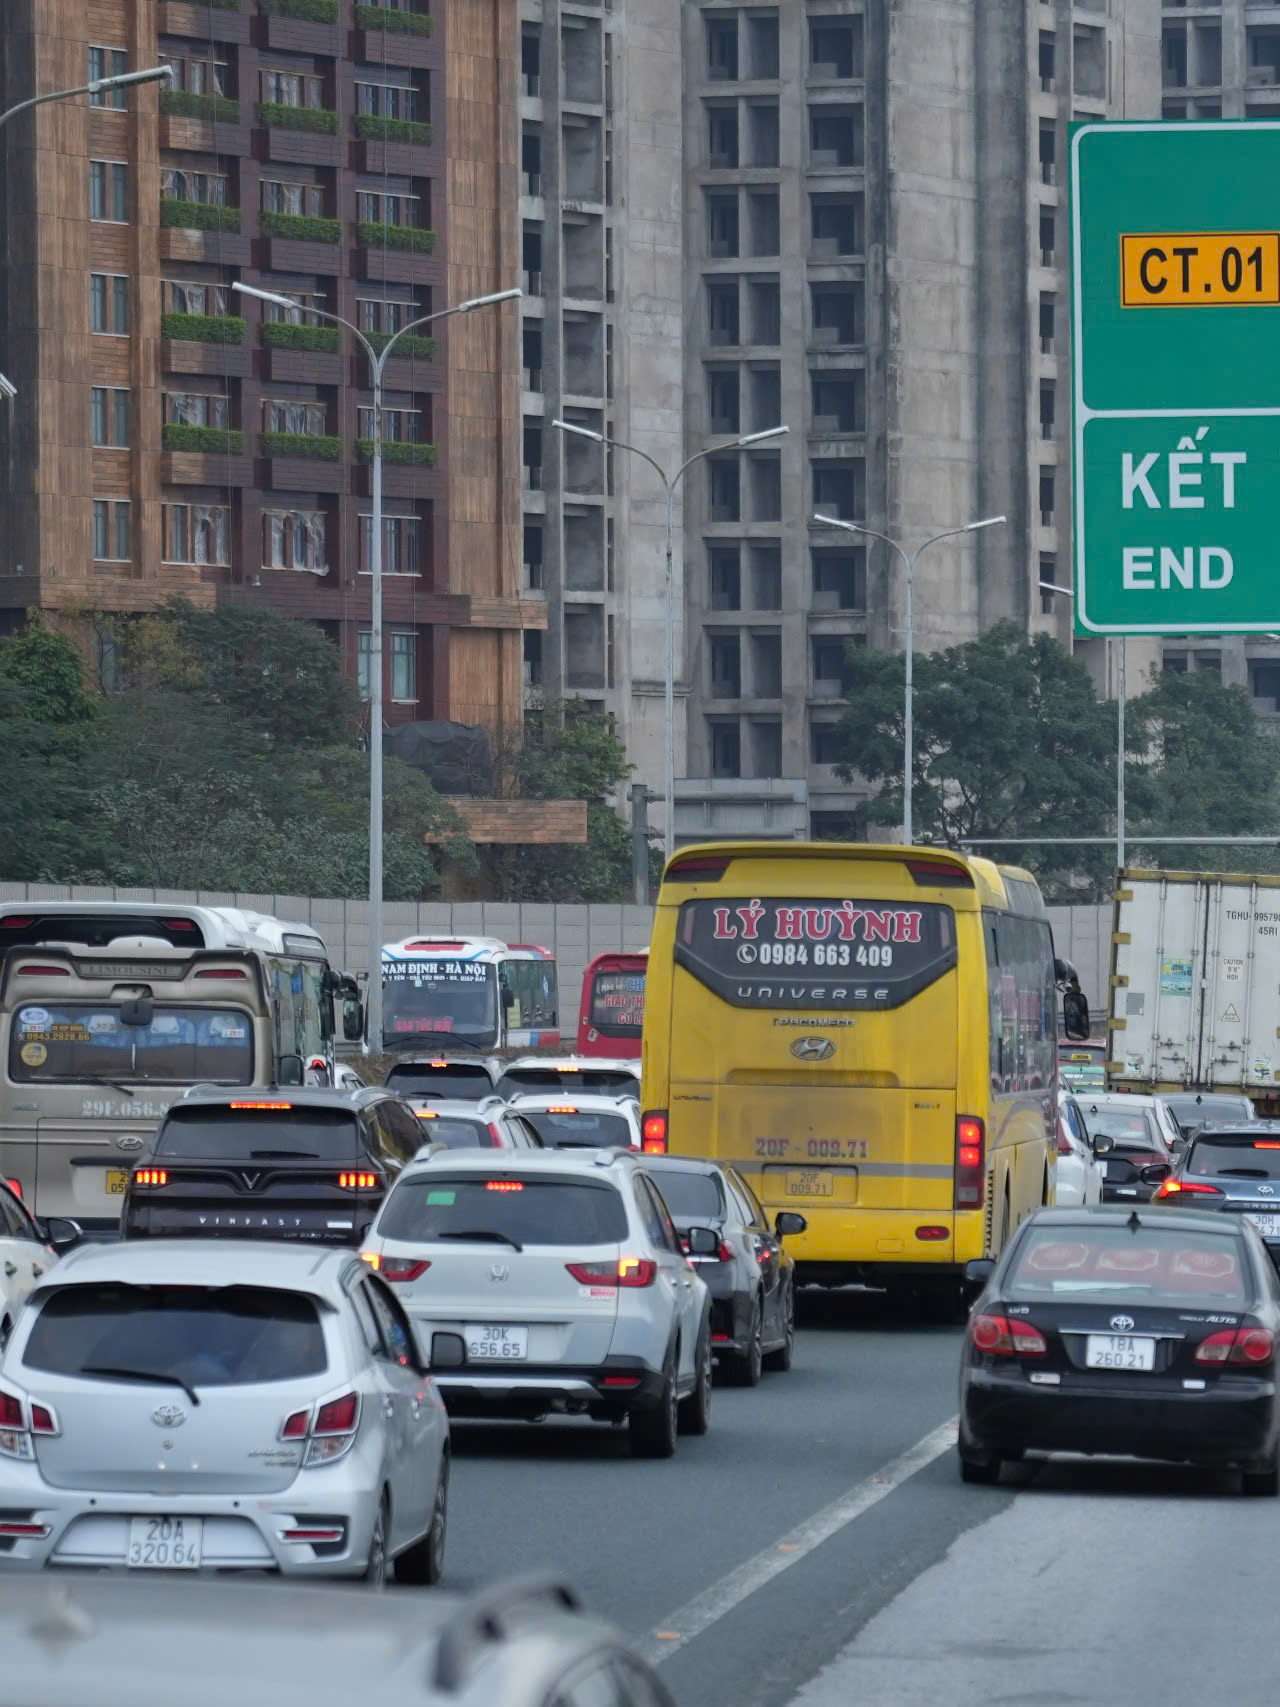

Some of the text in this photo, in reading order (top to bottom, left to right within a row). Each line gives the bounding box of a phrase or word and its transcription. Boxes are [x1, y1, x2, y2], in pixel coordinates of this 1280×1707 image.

[1140, 246, 1265, 294] CT.01
[1121, 427, 1247, 509] KẾT
[1122, 546, 1234, 590] END
[713, 899, 922, 942] LÝ HUỲNH
[759, 944, 893, 967] 0984 663 409
[88, 965, 176, 977] LIMOUSINE
[382, 963, 406, 975] NAM
[408, 963, 438, 977] ĐỊNH
[445, 961, 463, 974] HÀ
[465, 963, 486, 978] NỘI
[737, 986, 889, 1000] UNIVERSE
[756, 1137, 789, 1156] 20F
[807, 1139, 868, 1158] 009.71
[199, 1216, 301, 1226] VINFAST
[482, 1327, 509, 1341] 30K
[471, 1342, 521, 1357] 656.65
[1095, 1352, 1145, 1368] 260.21
[146, 1519, 185, 1541] 20A
[130, 1543, 196, 1564] 320.64
